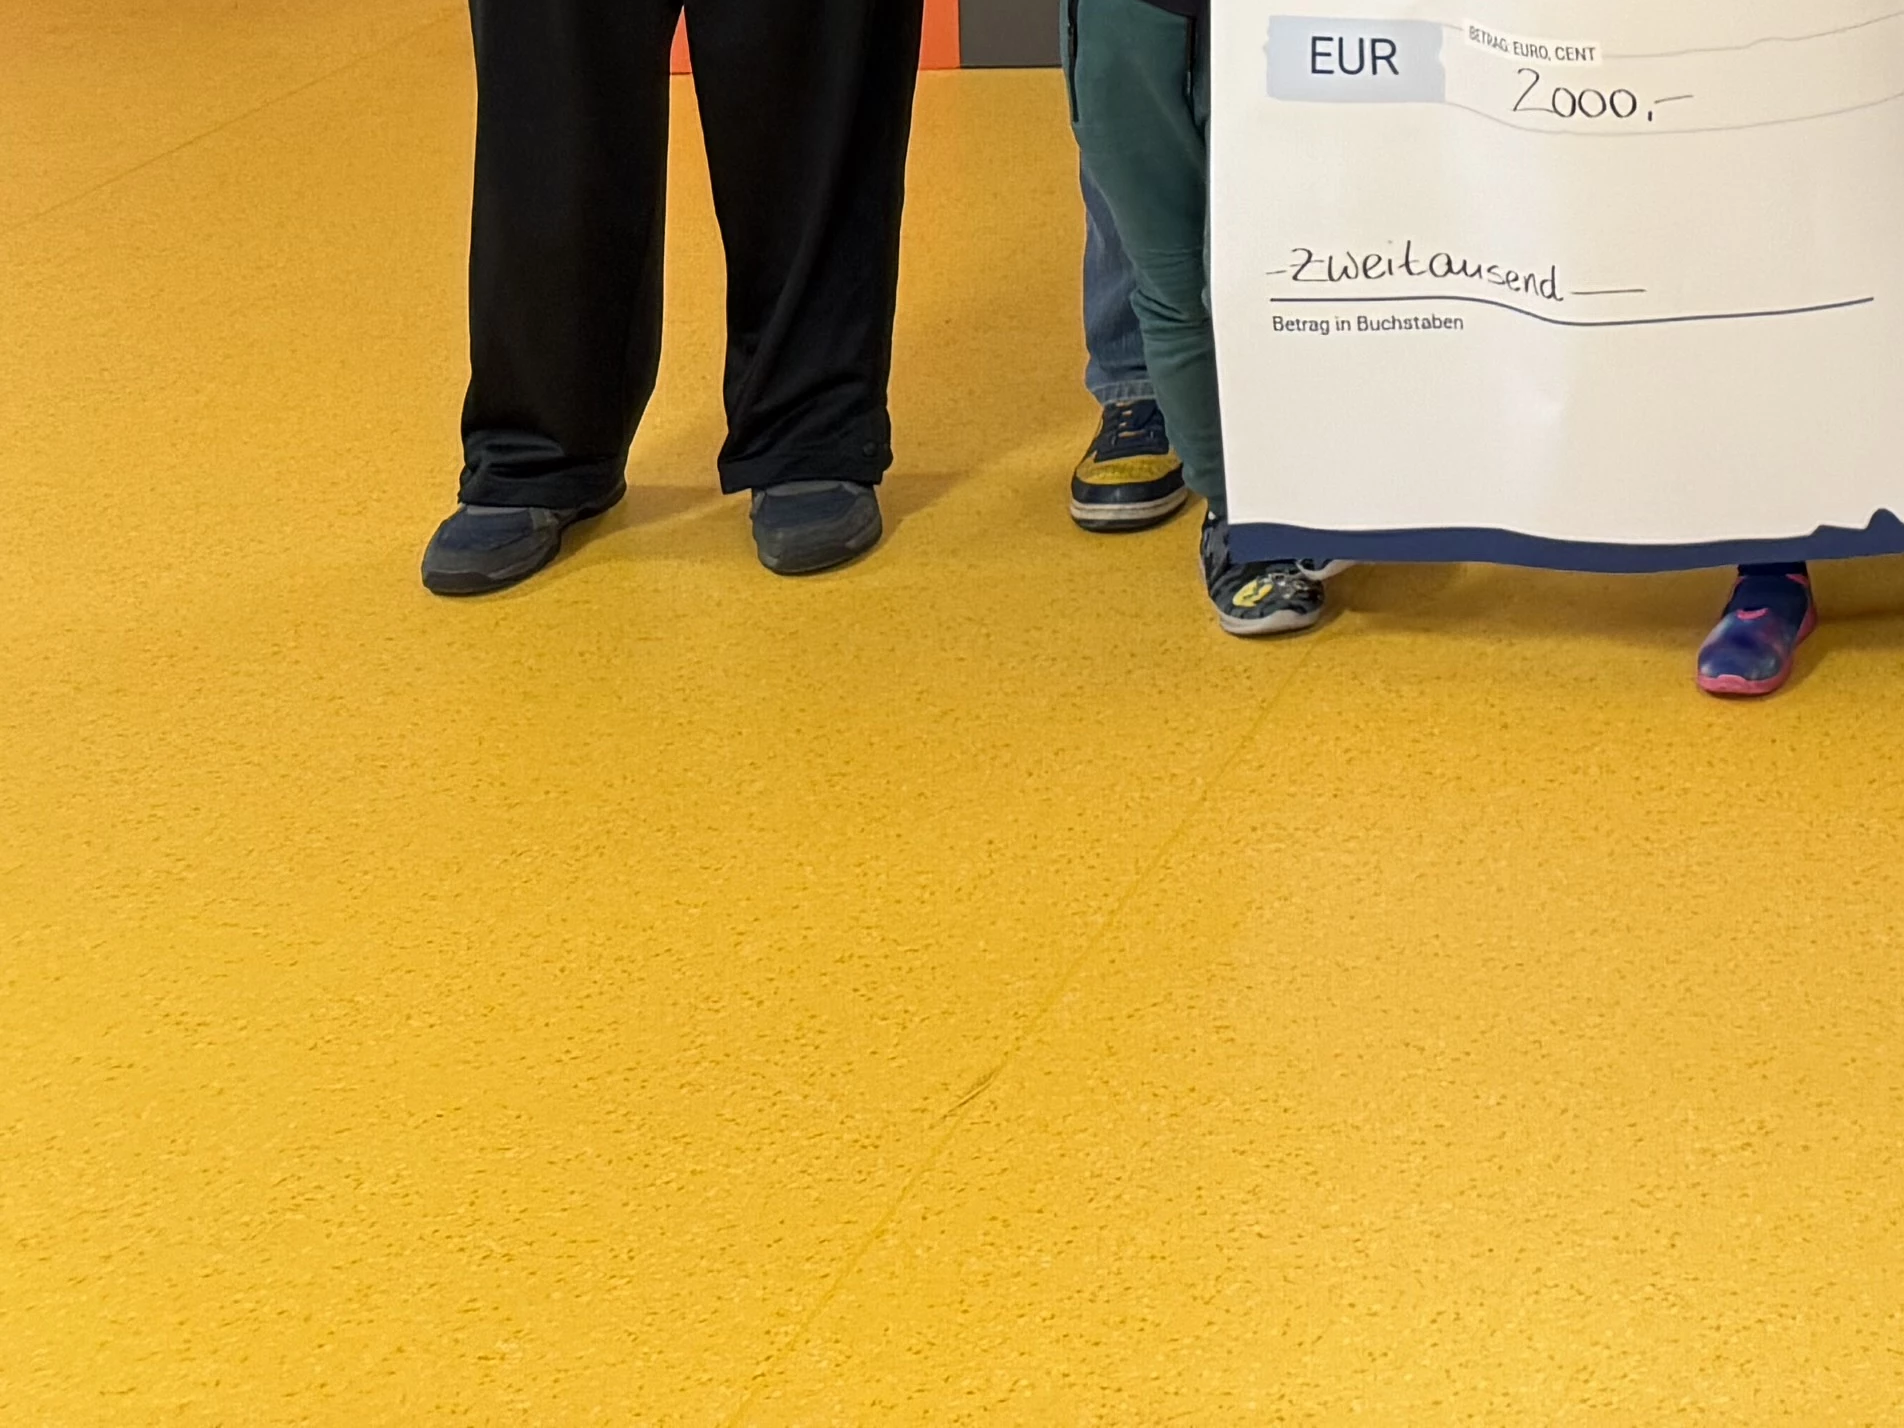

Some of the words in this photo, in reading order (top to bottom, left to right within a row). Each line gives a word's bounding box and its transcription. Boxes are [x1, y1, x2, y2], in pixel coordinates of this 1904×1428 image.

[1309, 35, 1401, 77] EUR
[1554, 46, 1597, 62] CENT
[1272, 314, 1330, 336] Betrag
[1335, 315, 1352, 332] in
[1357, 314, 1465, 332] Buchstaben
